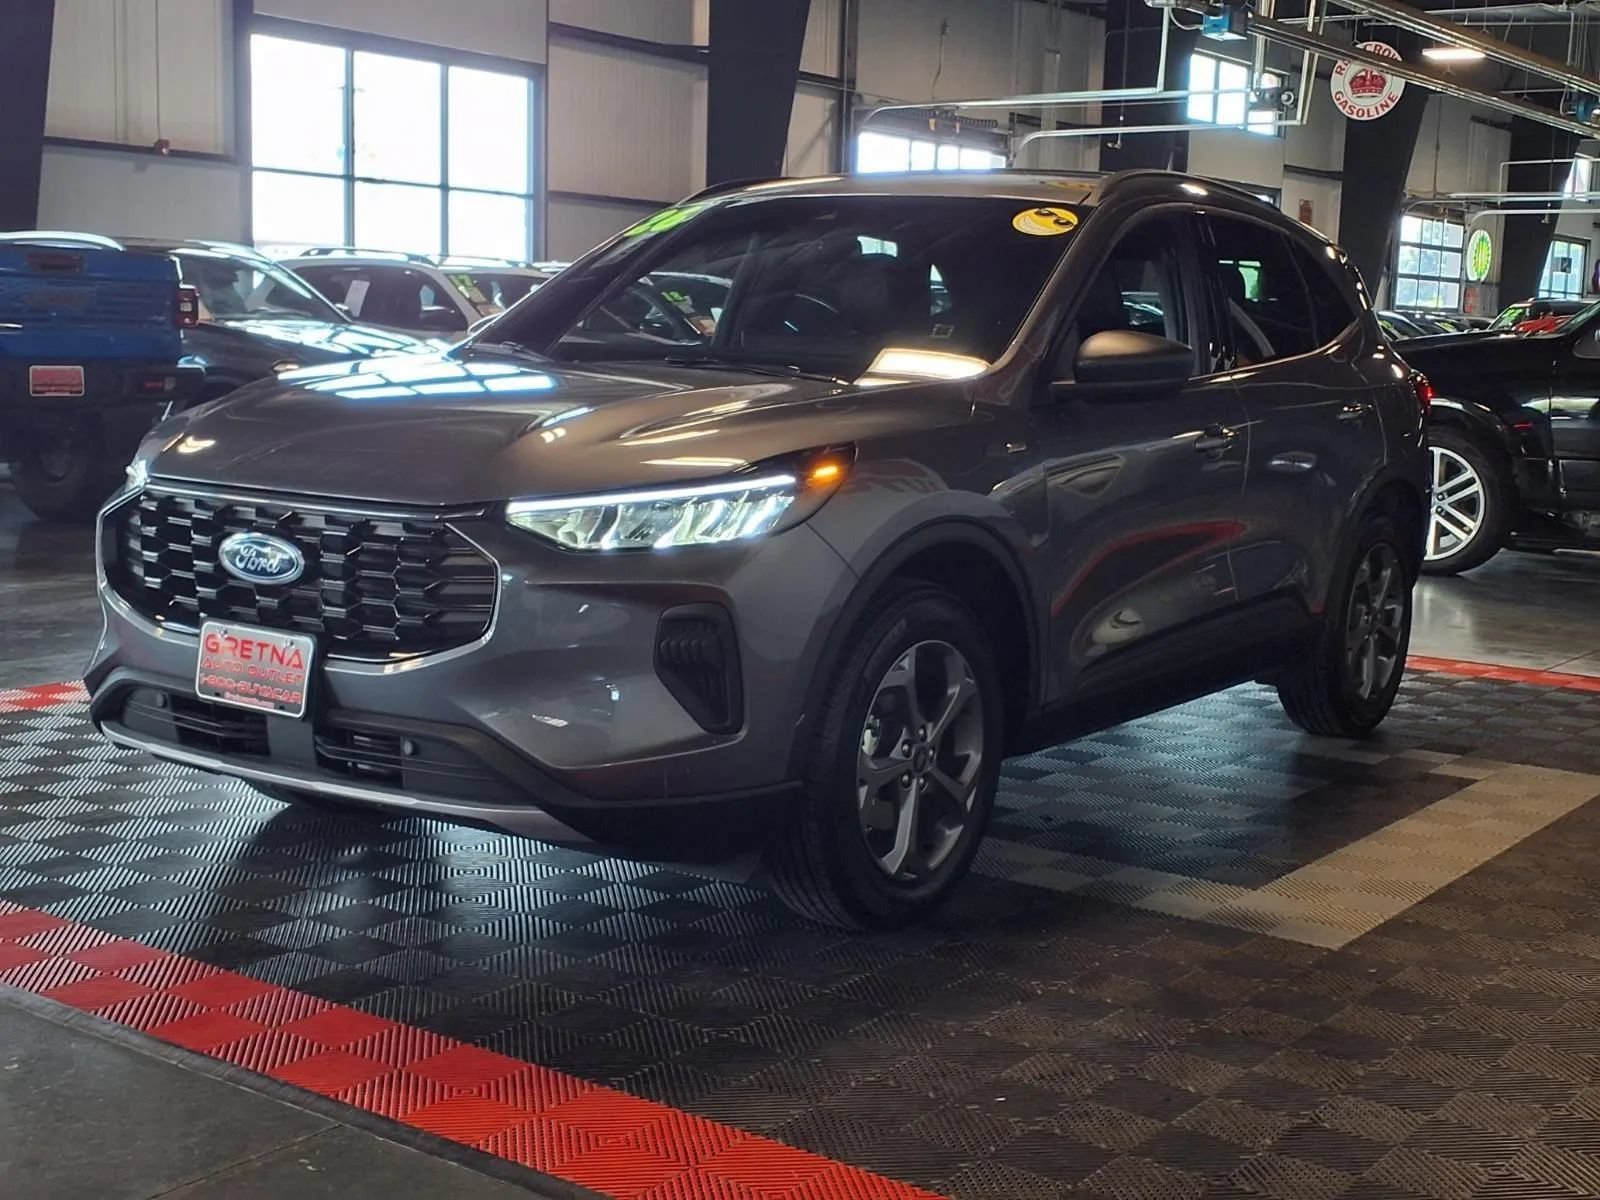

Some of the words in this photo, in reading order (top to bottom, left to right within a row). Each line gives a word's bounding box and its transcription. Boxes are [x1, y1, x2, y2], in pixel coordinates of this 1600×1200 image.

[1334, 91, 1398, 118] GASOLINE
[236, 543, 280, 573] Ford
[204, 633, 303, 670] GRETNA
[201, 656, 243, 673] AUTO
[247, 664, 304, 686] OUTLET
